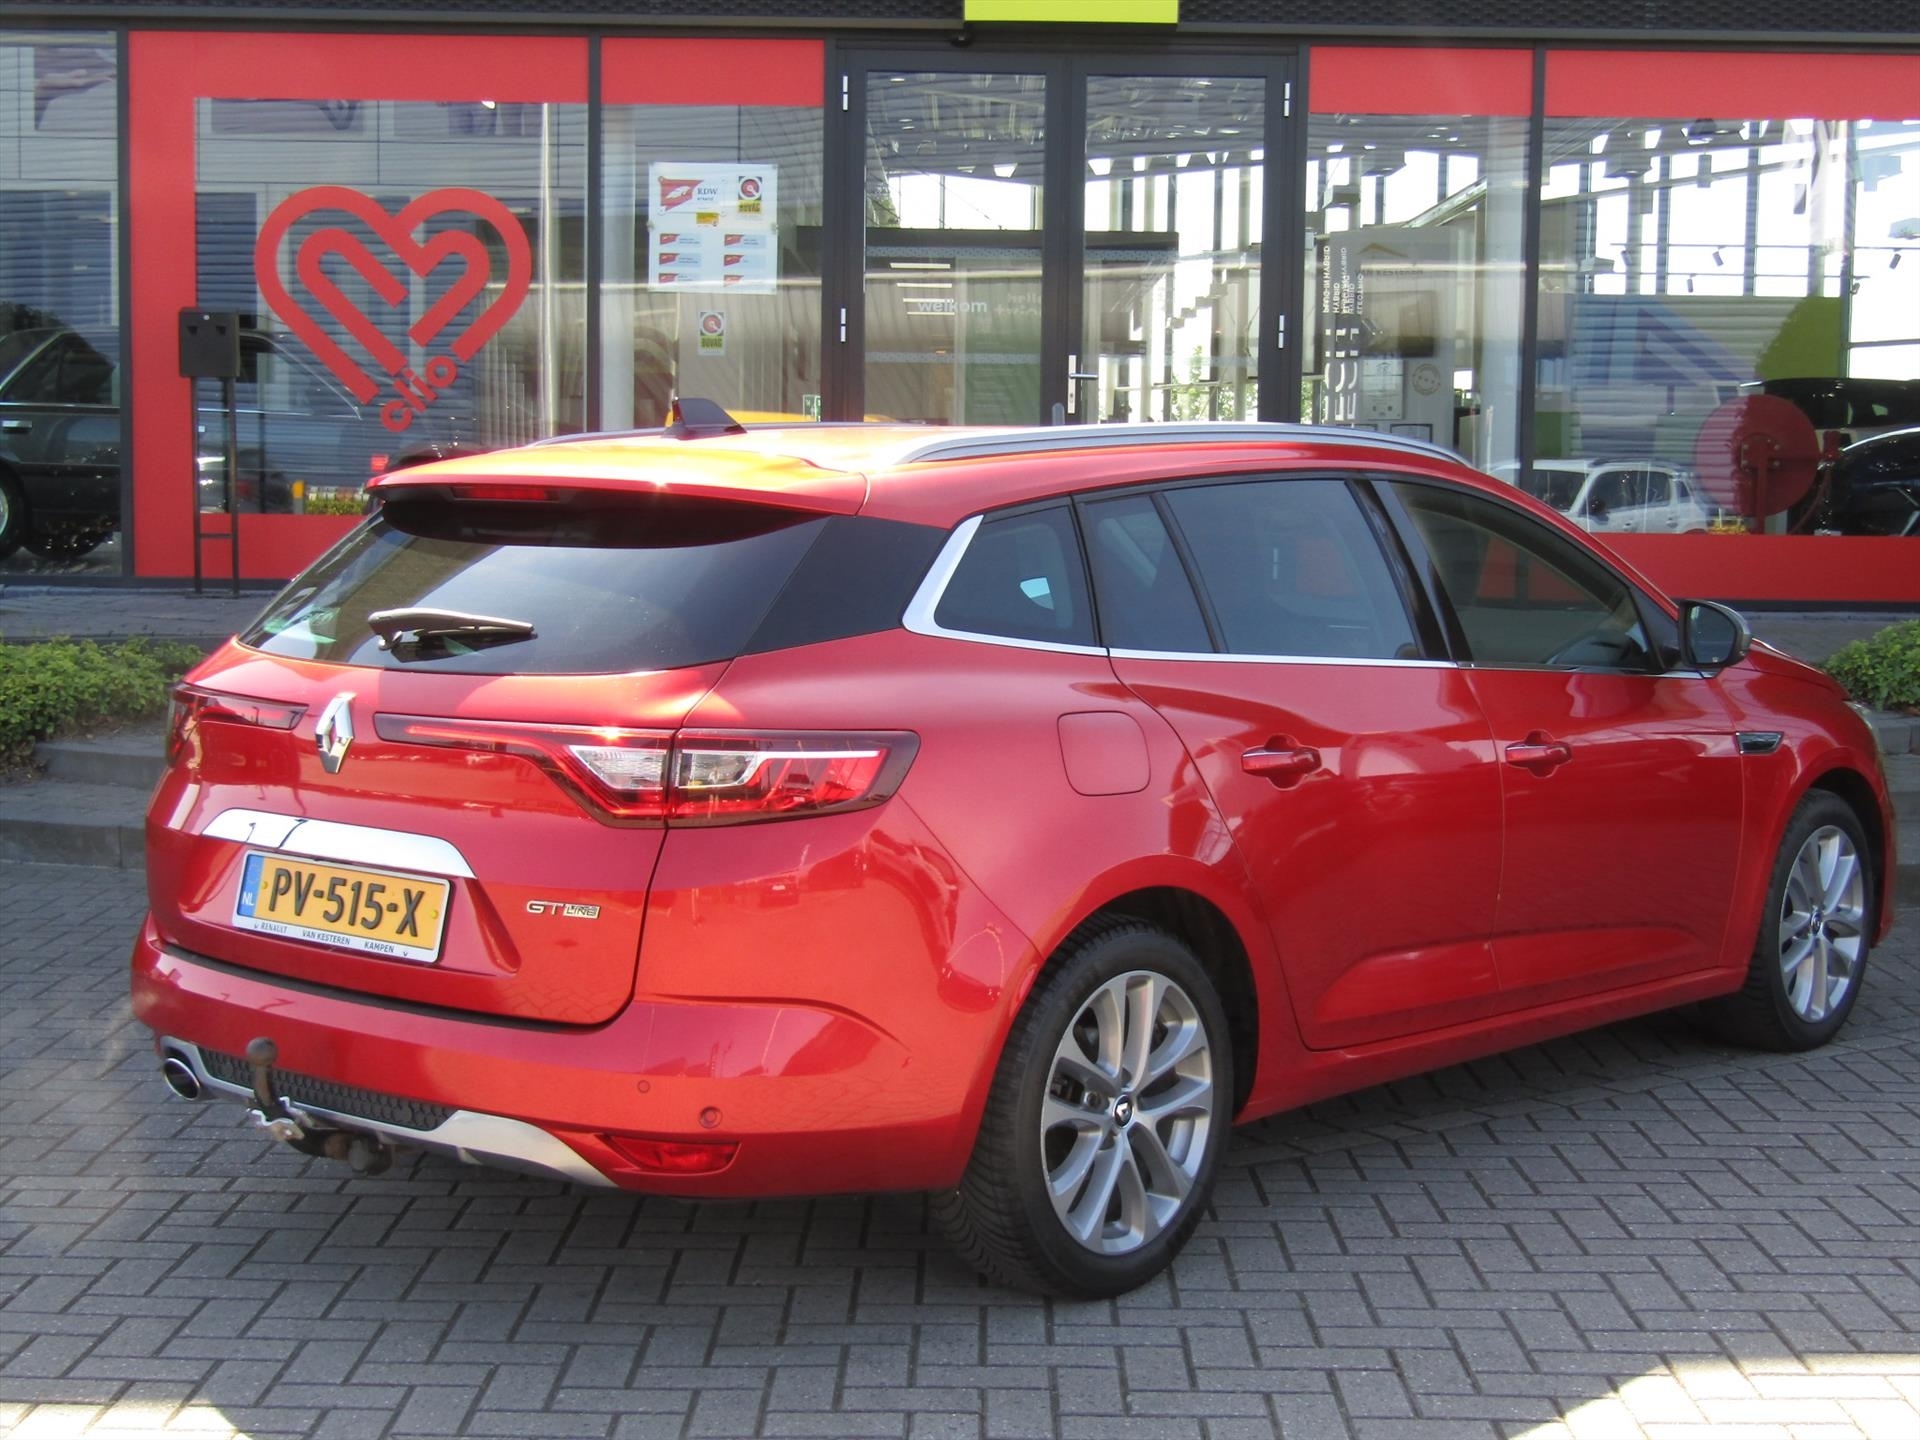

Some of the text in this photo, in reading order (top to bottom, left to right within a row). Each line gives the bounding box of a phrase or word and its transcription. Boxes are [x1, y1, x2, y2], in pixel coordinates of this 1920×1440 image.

[918, 298, 988, 313] welkom
[381, 356, 457, 432] clio
[241, 890, 255, 907] NL
[268, 867, 425, 938] PV-515-X
[526, 900, 565, 915] GT
[261, 921, 394, 954] RENAULT VAN KESTEREN KAMPEN
